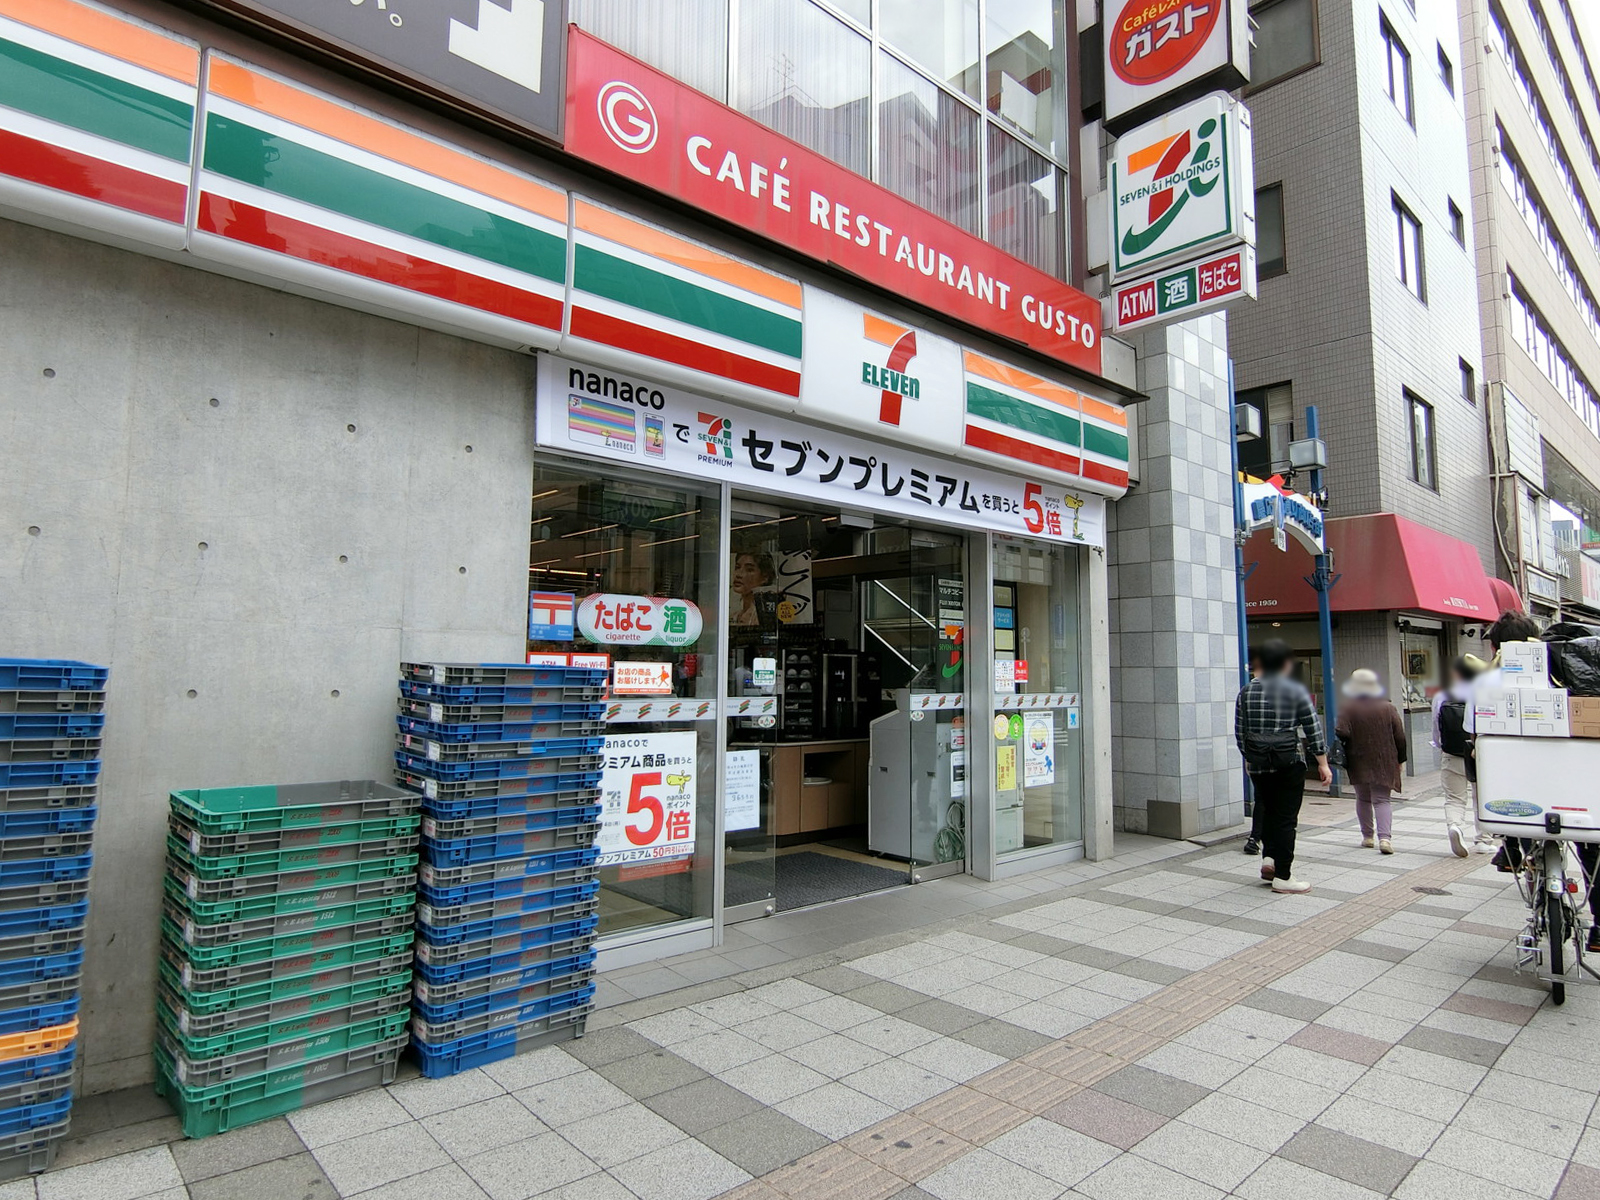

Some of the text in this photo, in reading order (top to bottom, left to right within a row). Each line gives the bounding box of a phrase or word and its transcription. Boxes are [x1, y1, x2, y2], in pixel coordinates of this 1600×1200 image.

[1125, 4, 1209, 65] ガスト
[1165, 157, 1220, 188] HOLDINGS
[686, 135, 1096, 351] CAFÉ RESTAURANT GUSTO
[1165, 277, 1188, 308] 酒
[1201, 262, 1239, 296] たばこ
[1121, 287, 1153, 320] ATM
[569, 367, 665, 411] nanaco
[697, 455, 733, 468] PREMIUM
[673, 423, 690, 444] で
[1023, 482, 1044, 534] 5
[1046, 510, 1062, 535] 倍
[595, 601, 652, 631] たばこ
[663, 605, 687, 634] 酒
[605, 633, 641, 641] cigarette
[665, 634, 687, 643] liquor
[617, 668, 652, 676] お店の商品
[625, 772, 663, 846] 5
[666, 810, 691, 841] 倍
[666, 801, 691, 809] ポイント
